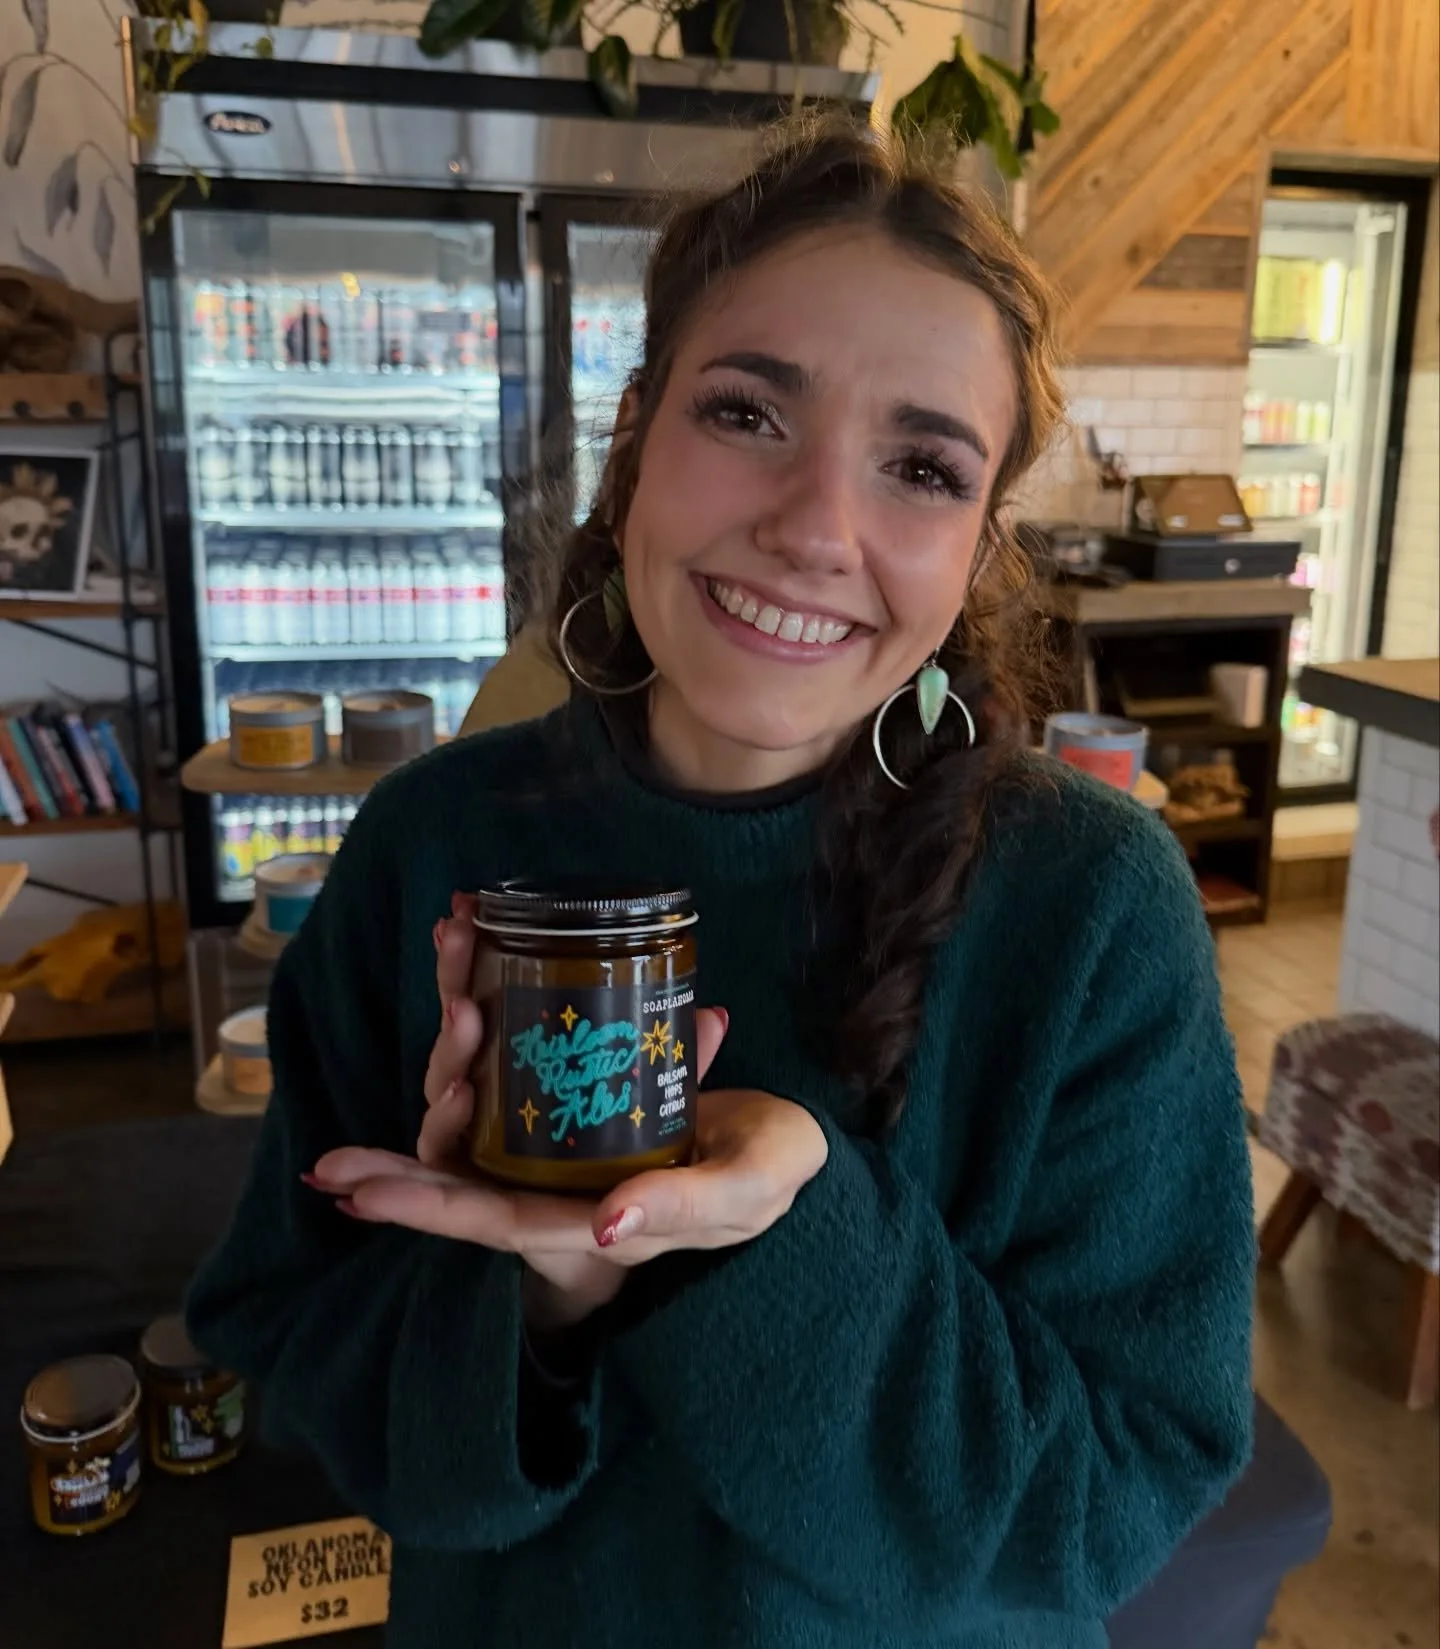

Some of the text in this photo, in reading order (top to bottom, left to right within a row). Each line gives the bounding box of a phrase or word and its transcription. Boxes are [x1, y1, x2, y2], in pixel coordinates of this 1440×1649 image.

[657, 1065, 688, 1087] BALSAM
[664, 1083, 683, 1100] HOPS
[659, 1097, 686, 1117] CITRUS
[263, 1530, 385, 1563] OKLAHOMA
[266, 1546, 382, 1579] NEON SIGN
[248, 1561, 388, 1598] SOY CANDLE
[301, 1597, 349, 1624] $32
